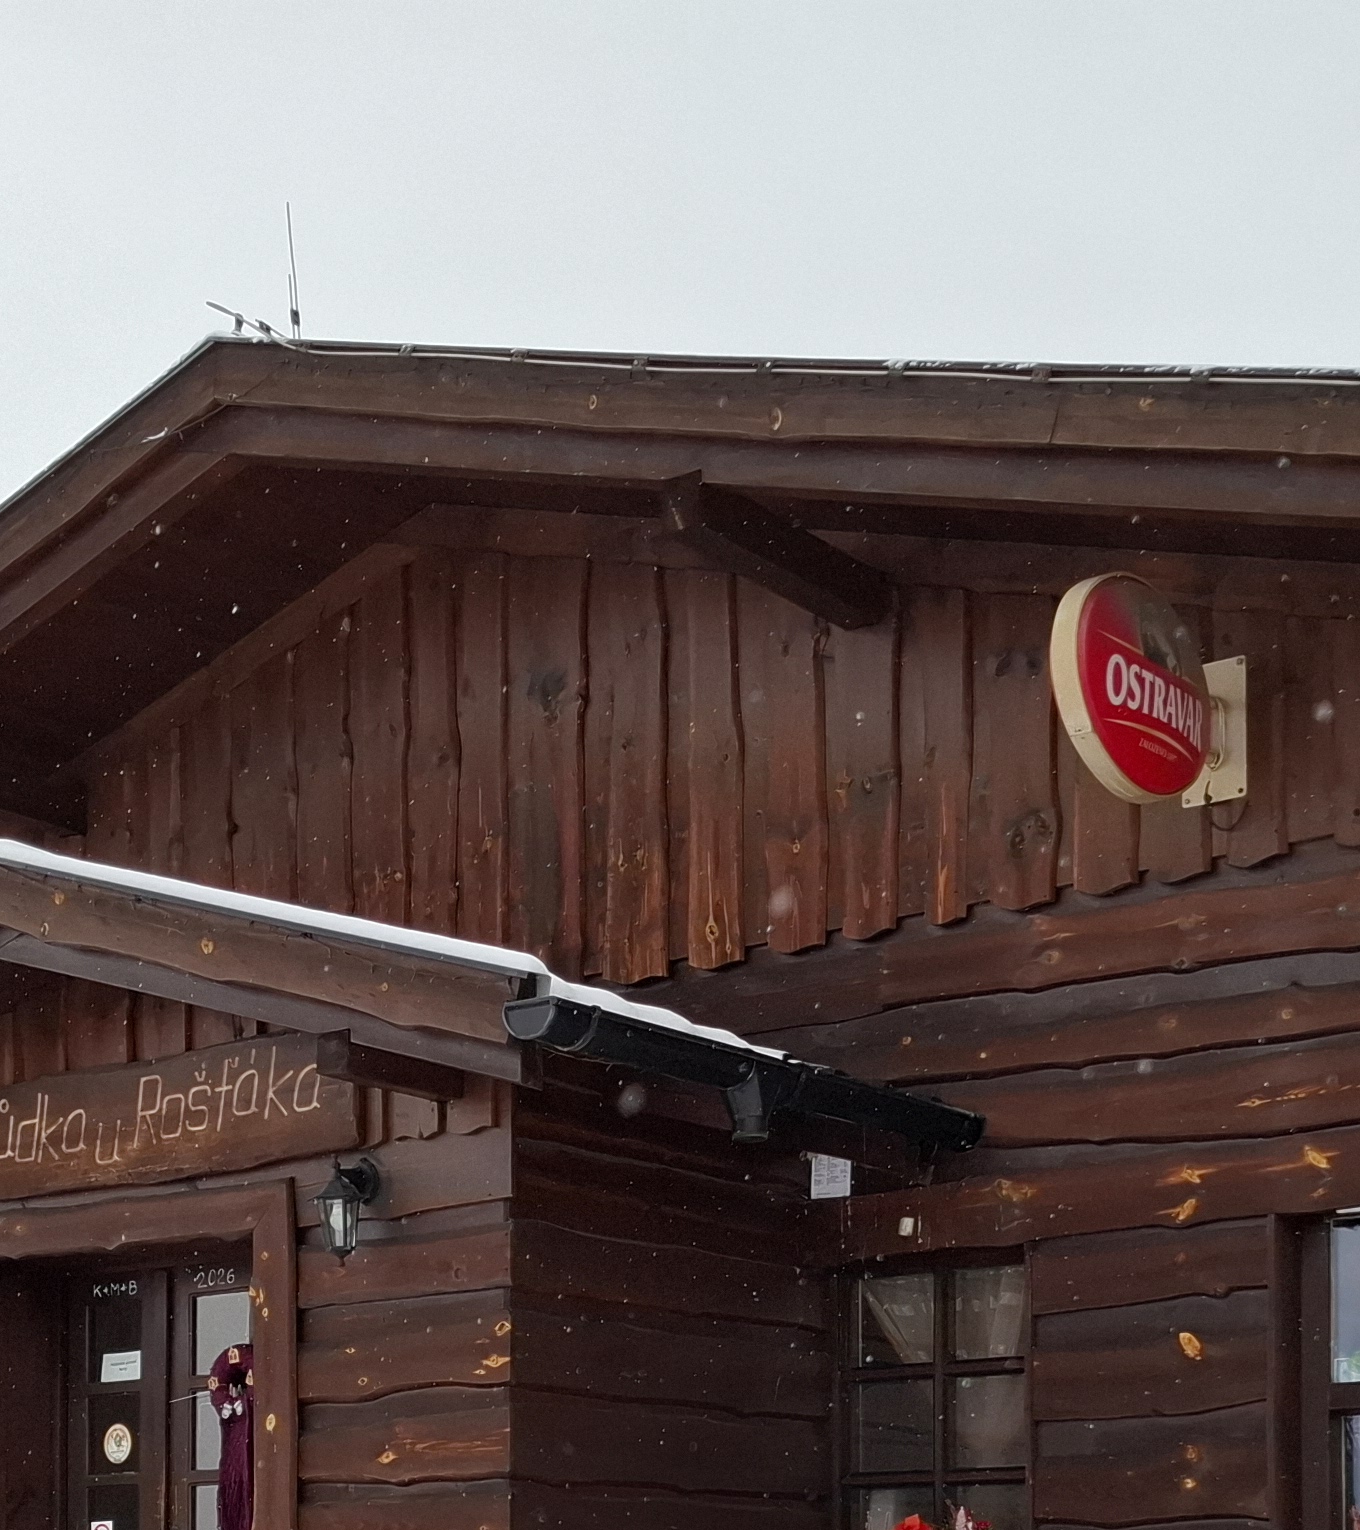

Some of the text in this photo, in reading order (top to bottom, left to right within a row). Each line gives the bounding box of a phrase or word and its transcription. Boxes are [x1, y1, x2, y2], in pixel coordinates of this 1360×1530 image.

[1106, 653, 1202, 753] OSTRAVAR
[94, 1118, 121, 1164] u
[133, 1045, 321, 1149] Rošťáka
[195, 1268, 235, 1289] 2026
